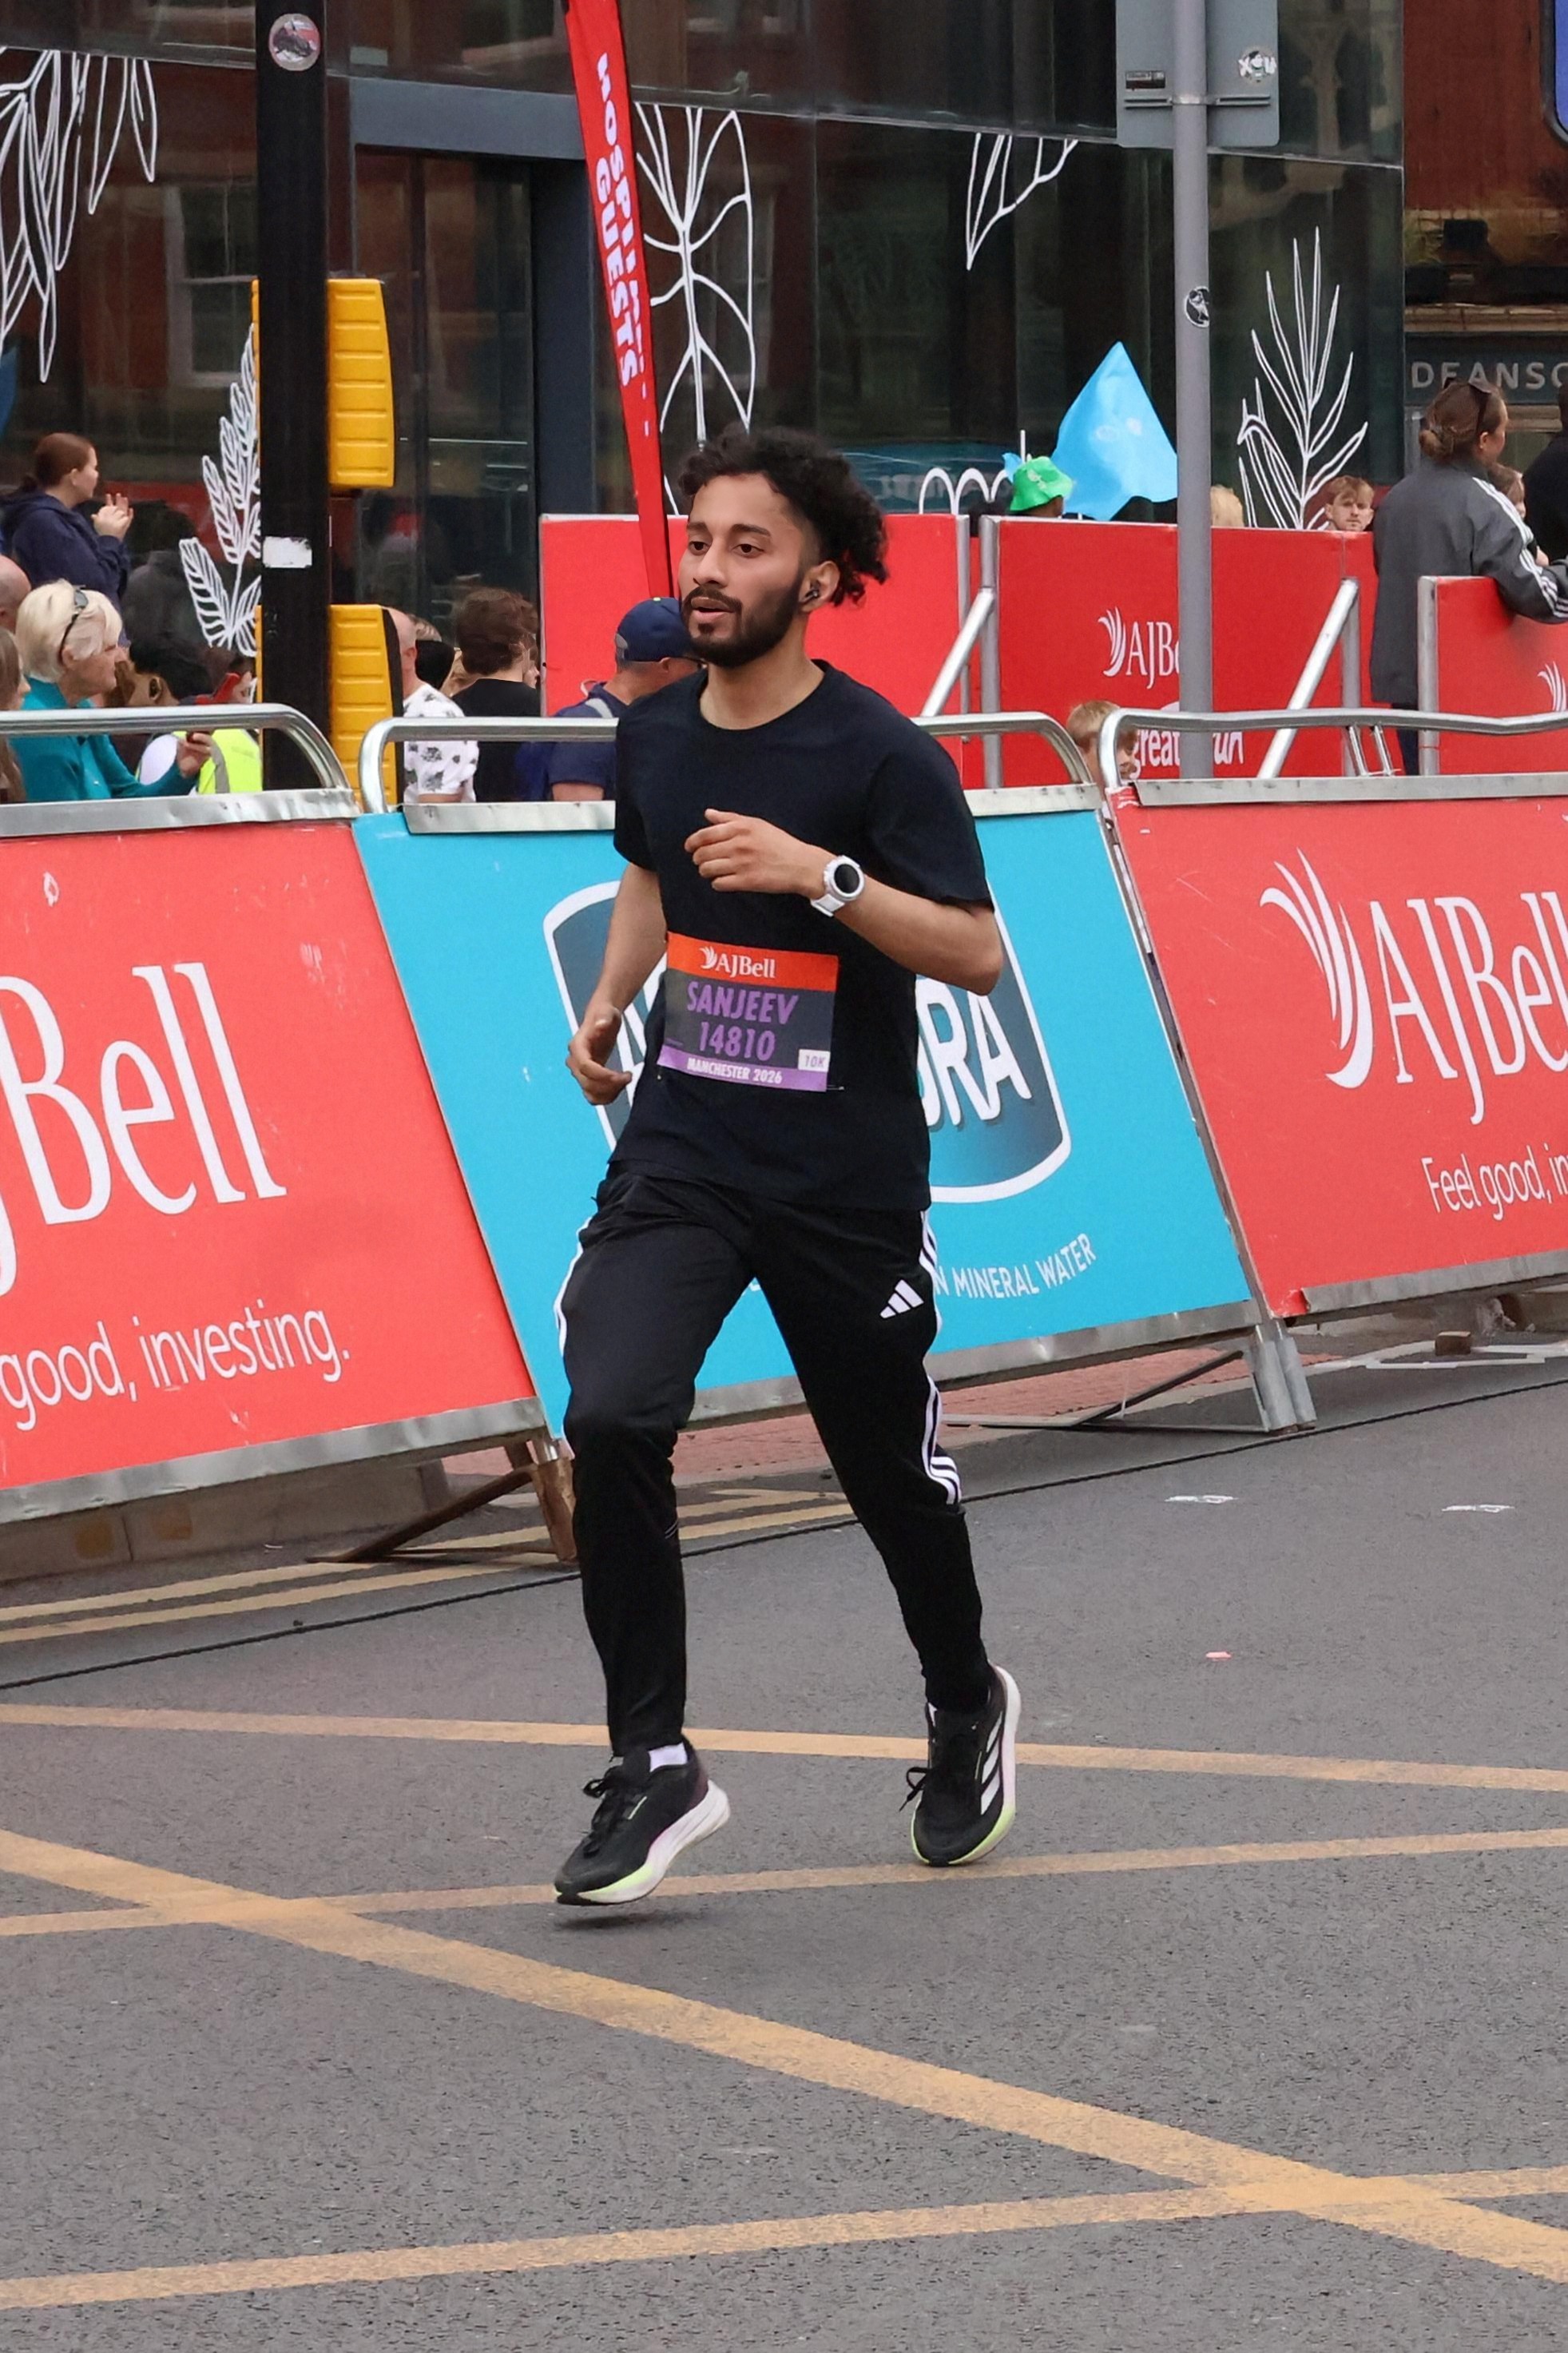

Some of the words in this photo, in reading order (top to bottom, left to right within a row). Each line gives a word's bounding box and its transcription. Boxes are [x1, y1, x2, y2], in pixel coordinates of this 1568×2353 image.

[596, 157, 639, 387] GUESTS
[1125, 620, 1180, 690] AJB
[1212, 730, 1244, 765] un
[715, 952, 776, 980] AJBell
[687, 980, 799, 1025] SANJEEV
[699, 1021, 776, 1062] 14810
[804, 1054, 827, 1068] 10K
[686, 1057, 751, 1080] MANCHESTER
[752, 1068, 783, 1084] 2026
[0, 962, 288, 1297] Bell
[1421, 1153, 1482, 1213] Feel
[1479, 1144, 1553, 1221] good,
[951, 1264, 1040, 1299] MINERAL
[1035, 1233, 1097, 1290] WATER
[0, 1321, 137, 1431] good,
[132, 1298, 351, 1388] investing.
